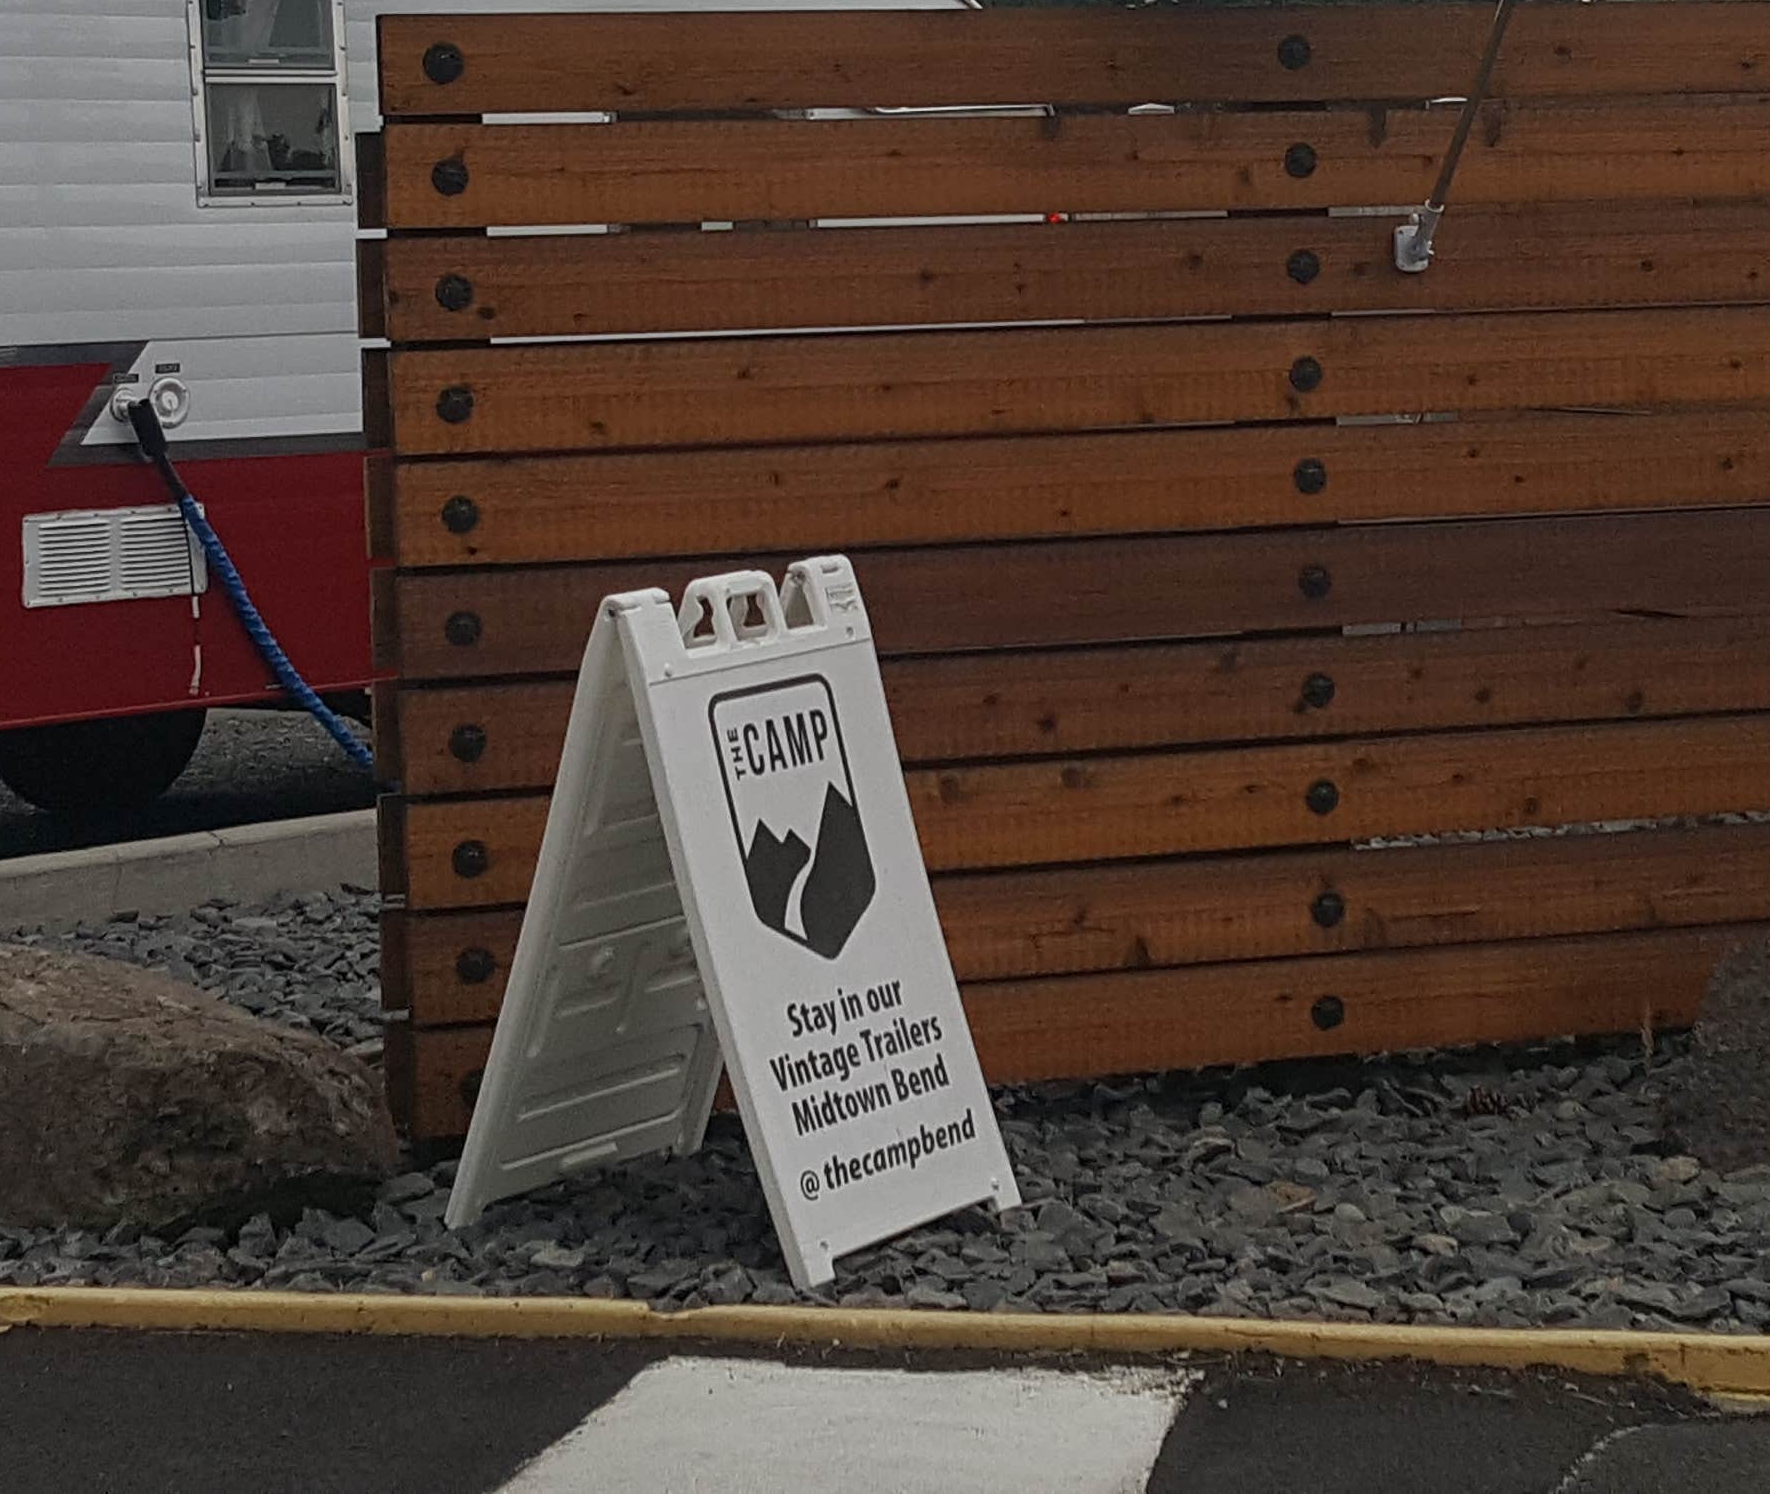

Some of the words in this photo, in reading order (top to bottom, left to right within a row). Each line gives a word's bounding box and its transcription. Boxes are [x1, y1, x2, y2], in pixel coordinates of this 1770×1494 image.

[727, 728, 746, 780] THE
[743, 709, 827, 776] CAMP
[787, 1000, 837, 1037] Stay
[837, 988, 864, 1021] in
[866, 980, 902, 1013] our
[769, 1043, 861, 1091] Vintage
[859, 1016, 942, 1062] Trailers
[791, 1082, 892, 1136] Midtown
[891, 1053, 949, 1102] Bend
[800, 1170, 820, 1201] @
[824, 1108, 976, 1190] thecampbend
